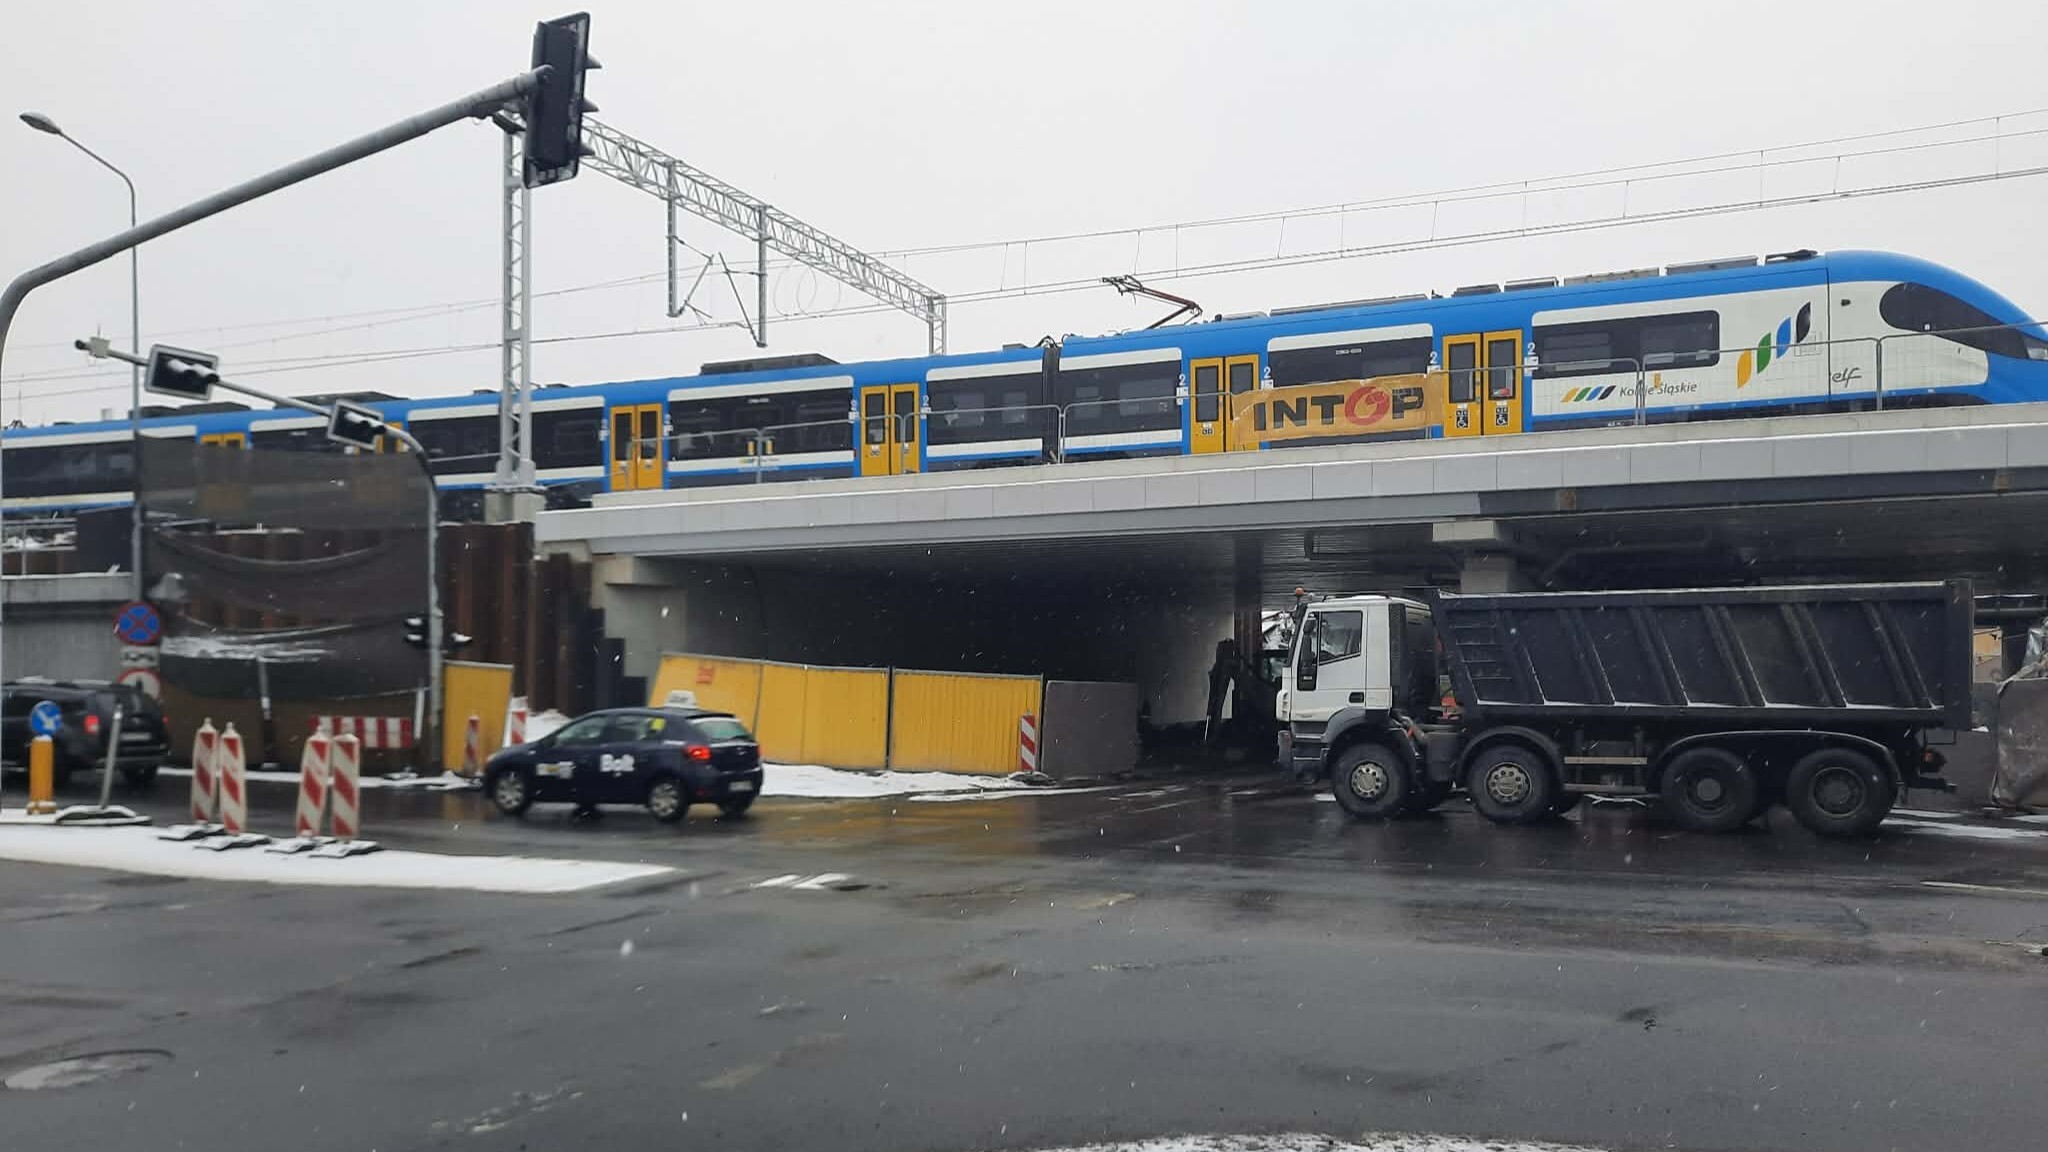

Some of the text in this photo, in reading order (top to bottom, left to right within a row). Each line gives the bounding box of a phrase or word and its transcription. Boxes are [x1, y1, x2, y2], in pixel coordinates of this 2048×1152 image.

[1527, 342, 1536, 355] 2
[1429, 351, 1438, 364] 2
[1263, 366, 1272, 379] 2
[1831, 367, 1862, 388] elf
[1178, 373, 1186, 386] 2
[1253, 385, 1424, 431] INTOP
